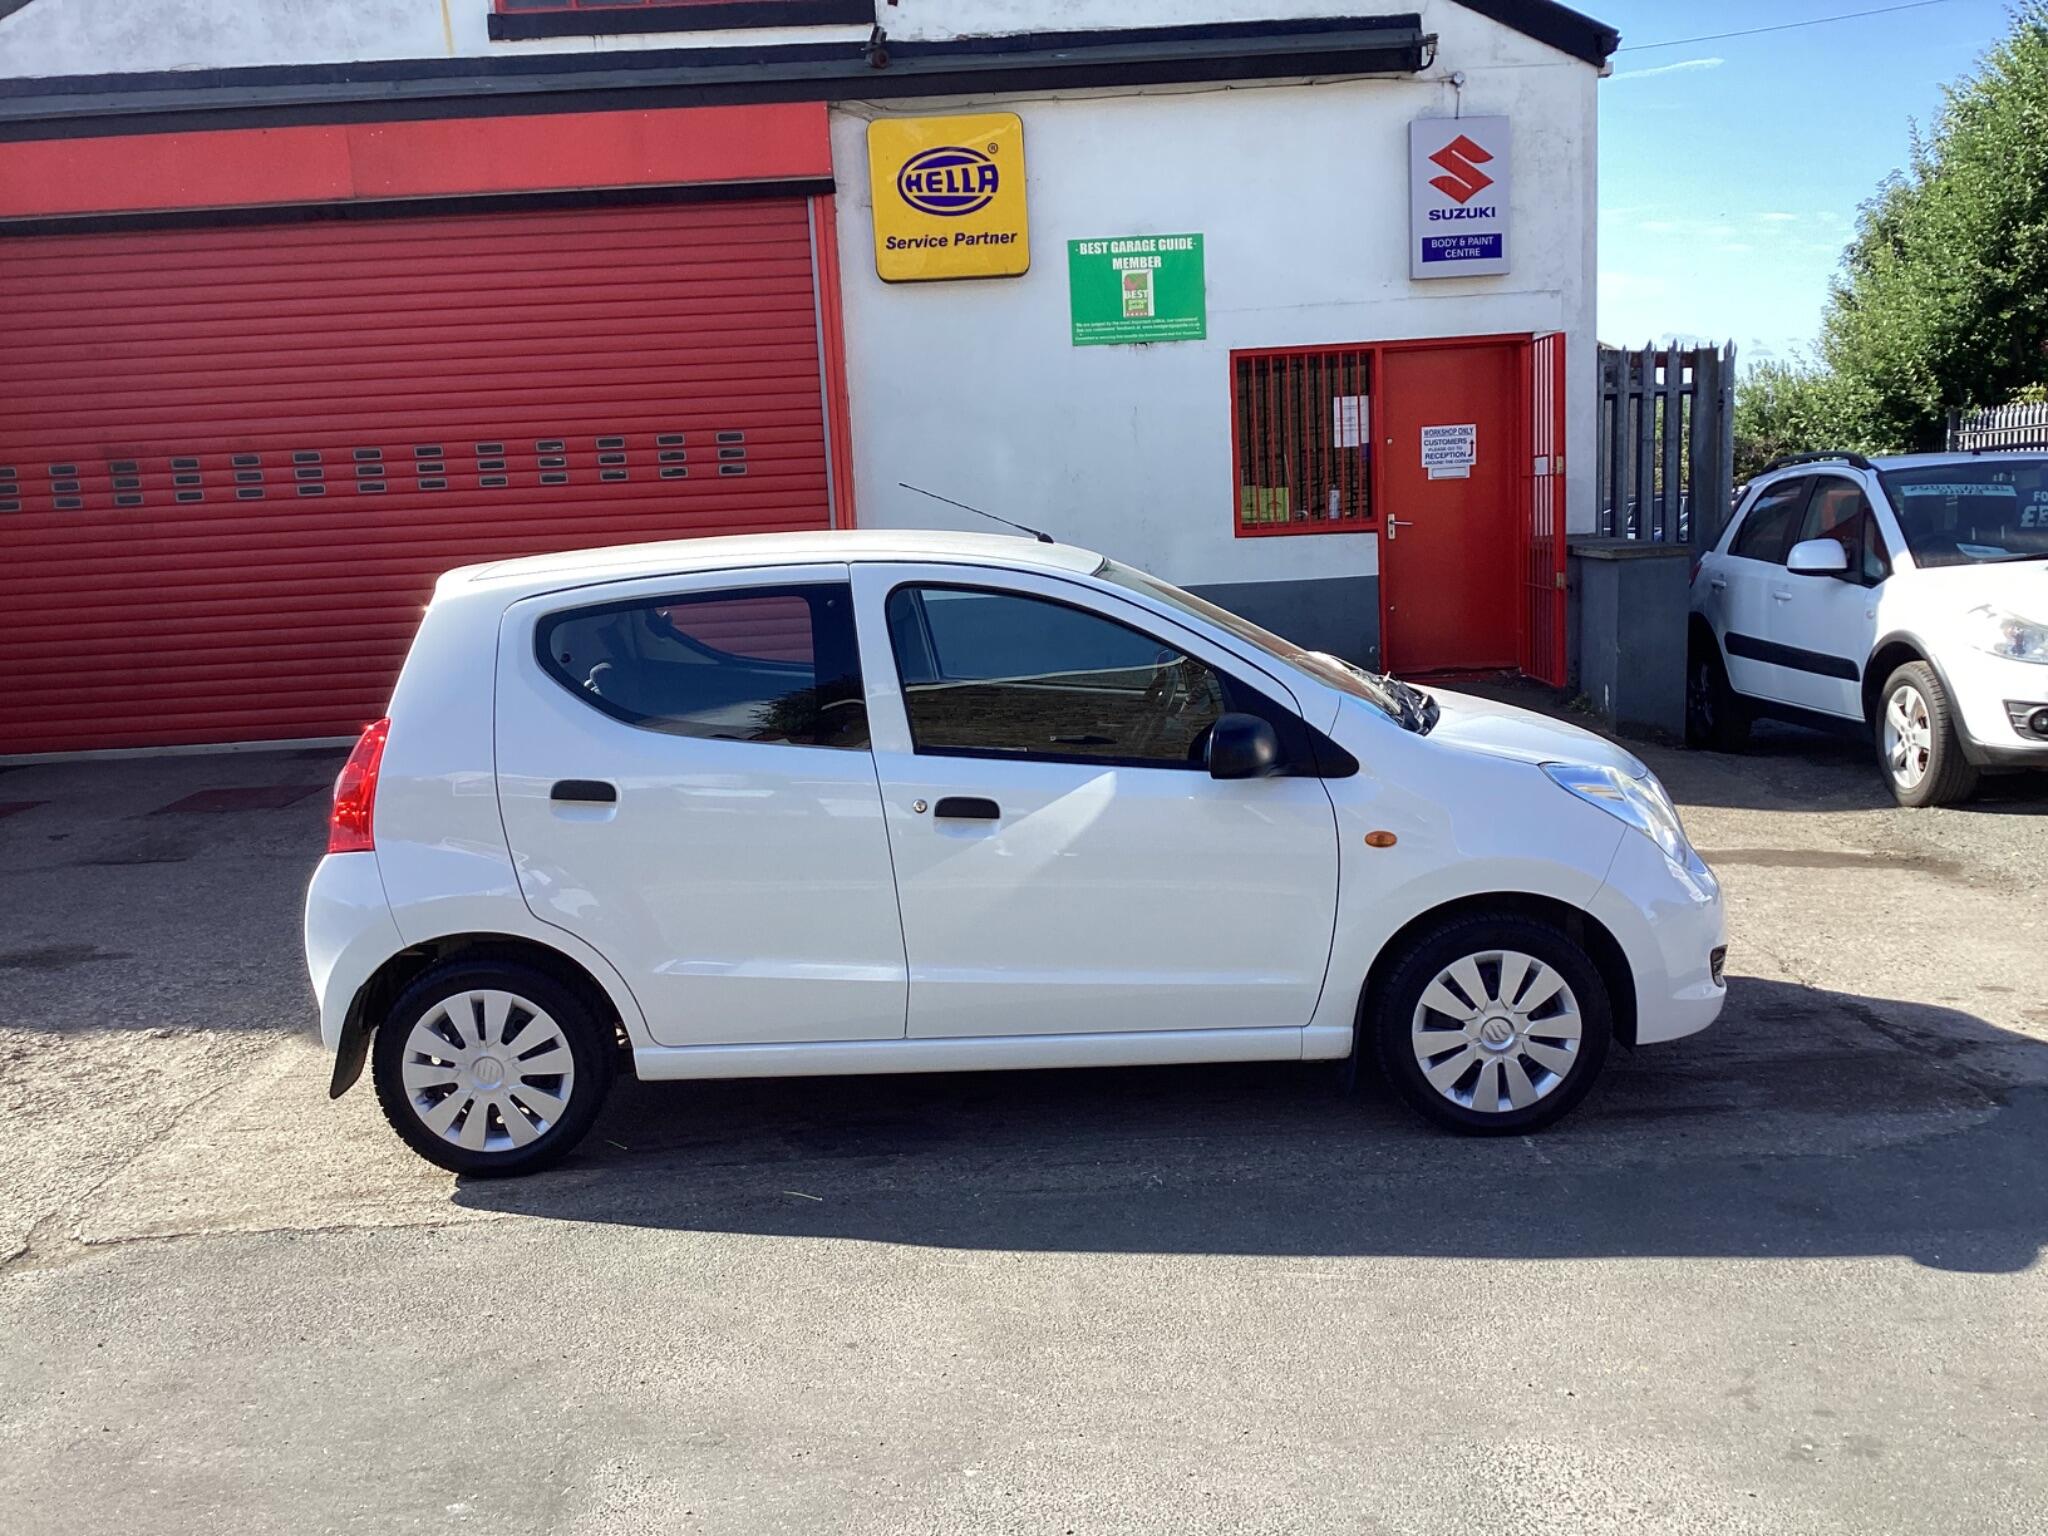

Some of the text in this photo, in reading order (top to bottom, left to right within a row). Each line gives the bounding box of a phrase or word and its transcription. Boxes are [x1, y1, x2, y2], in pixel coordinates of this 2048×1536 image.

[905, 163, 999, 193] HELLA
[1428, 206, 1496, 221] SUZUKI
[886, 231, 1018, 250] Service Partner
[1079, 237, 1194, 255] BEST GARAGE GUIDE
[1431, 238, 1456, 248] BODY
[1467, 236, 1494, 246] PAINT
[1445, 248, 1480, 258] CENTRE
[1112, 255, 1162, 270] MEMBER
[1424, 438, 1468, 446] CUSTOMERS
[1425, 451, 1467, 459] RECEPTION
